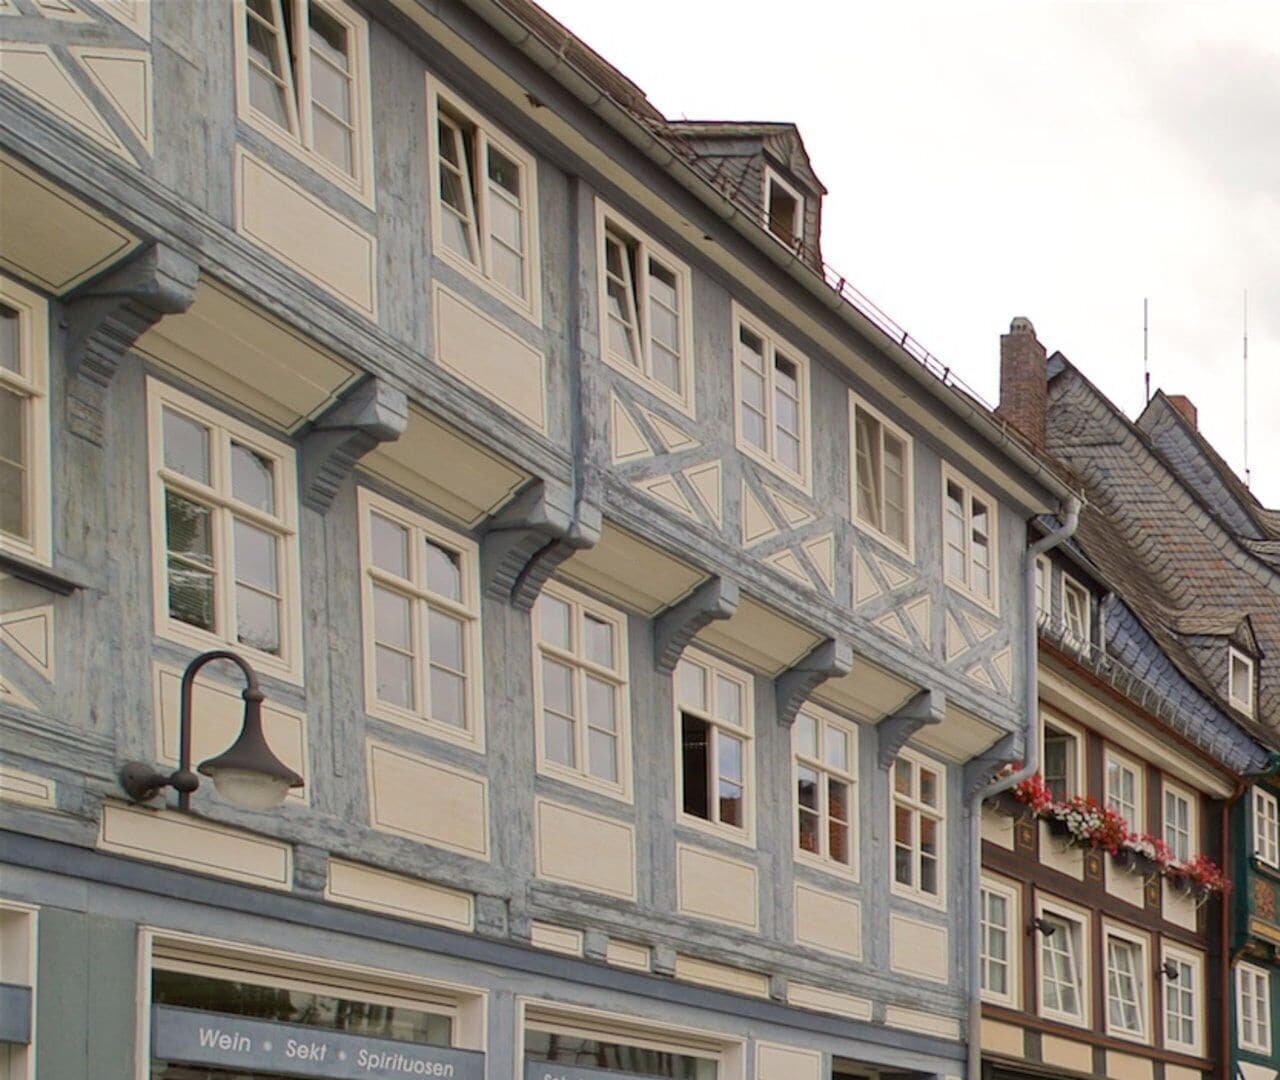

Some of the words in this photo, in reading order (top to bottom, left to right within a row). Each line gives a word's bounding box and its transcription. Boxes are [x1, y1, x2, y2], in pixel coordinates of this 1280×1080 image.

[199, 1028, 251, 1052] Wein
[285, 1039, 327, 1062] Sekt
[357, 1049, 454, 1078] Spirituosen
